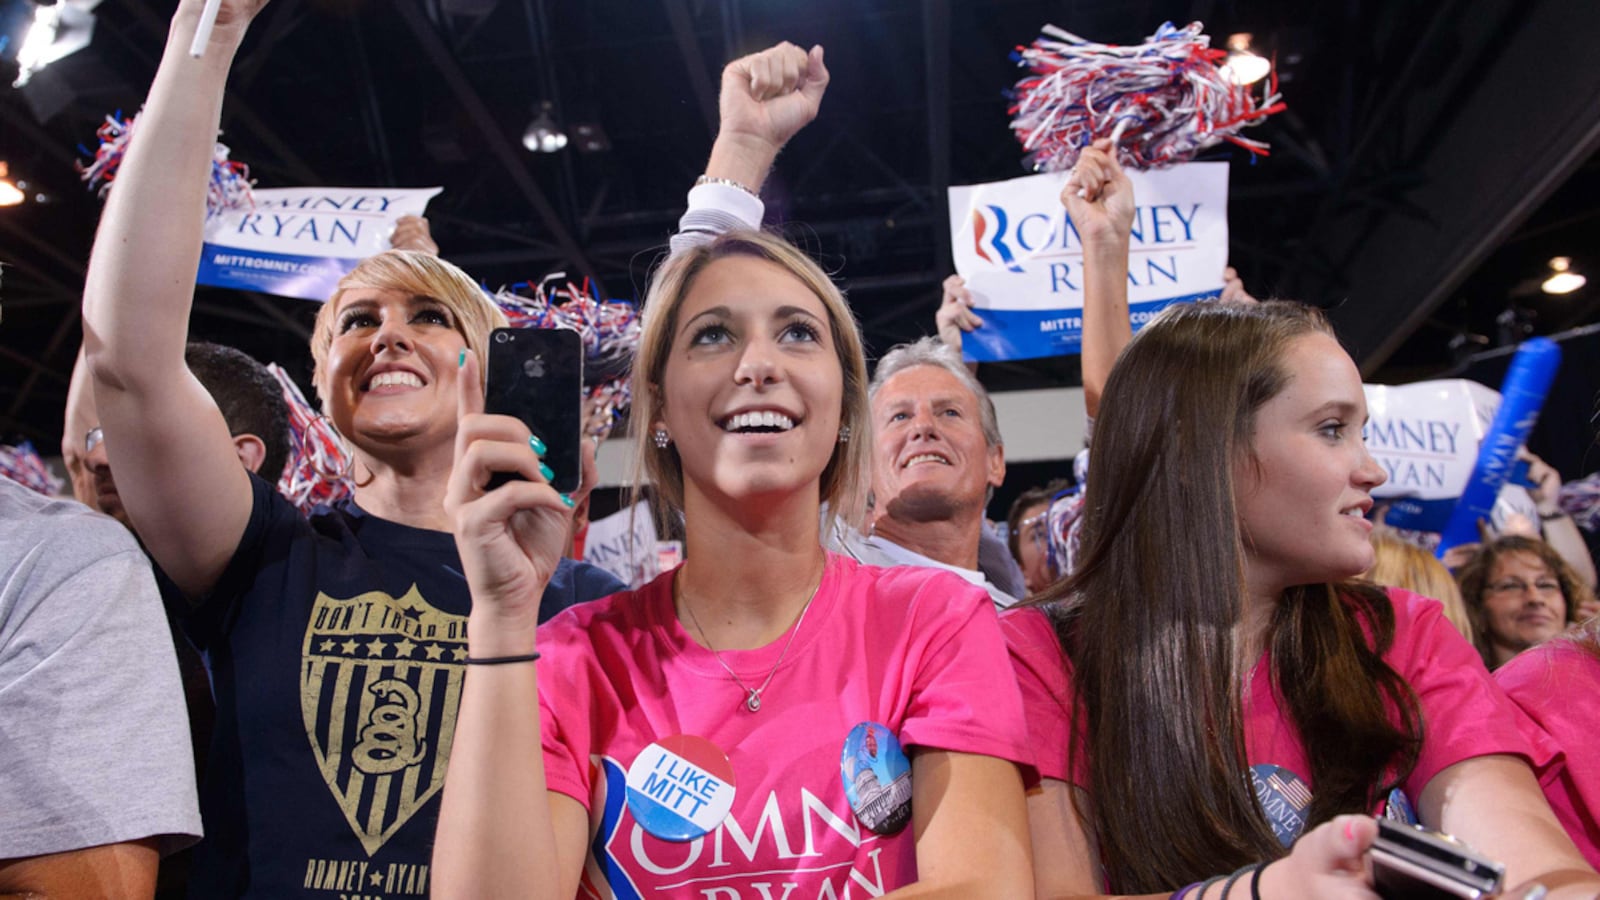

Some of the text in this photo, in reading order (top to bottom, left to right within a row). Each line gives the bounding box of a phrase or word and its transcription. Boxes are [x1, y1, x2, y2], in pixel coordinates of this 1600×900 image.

[237, 214, 361, 246] RYAN
[1050, 255, 1179, 293] RN
[1362, 418, 1461, 454] MNEY
[1376, 457, 1446, 488] YAN
[314, 602, 374, 631] DON'T
[380, 604, 437, 639] TREAD
[641, 771, 708, 818] MITT
[655, 753, 720, 800] I LIKE
[303, 858, 429, 895] ROMNEY RYAN
